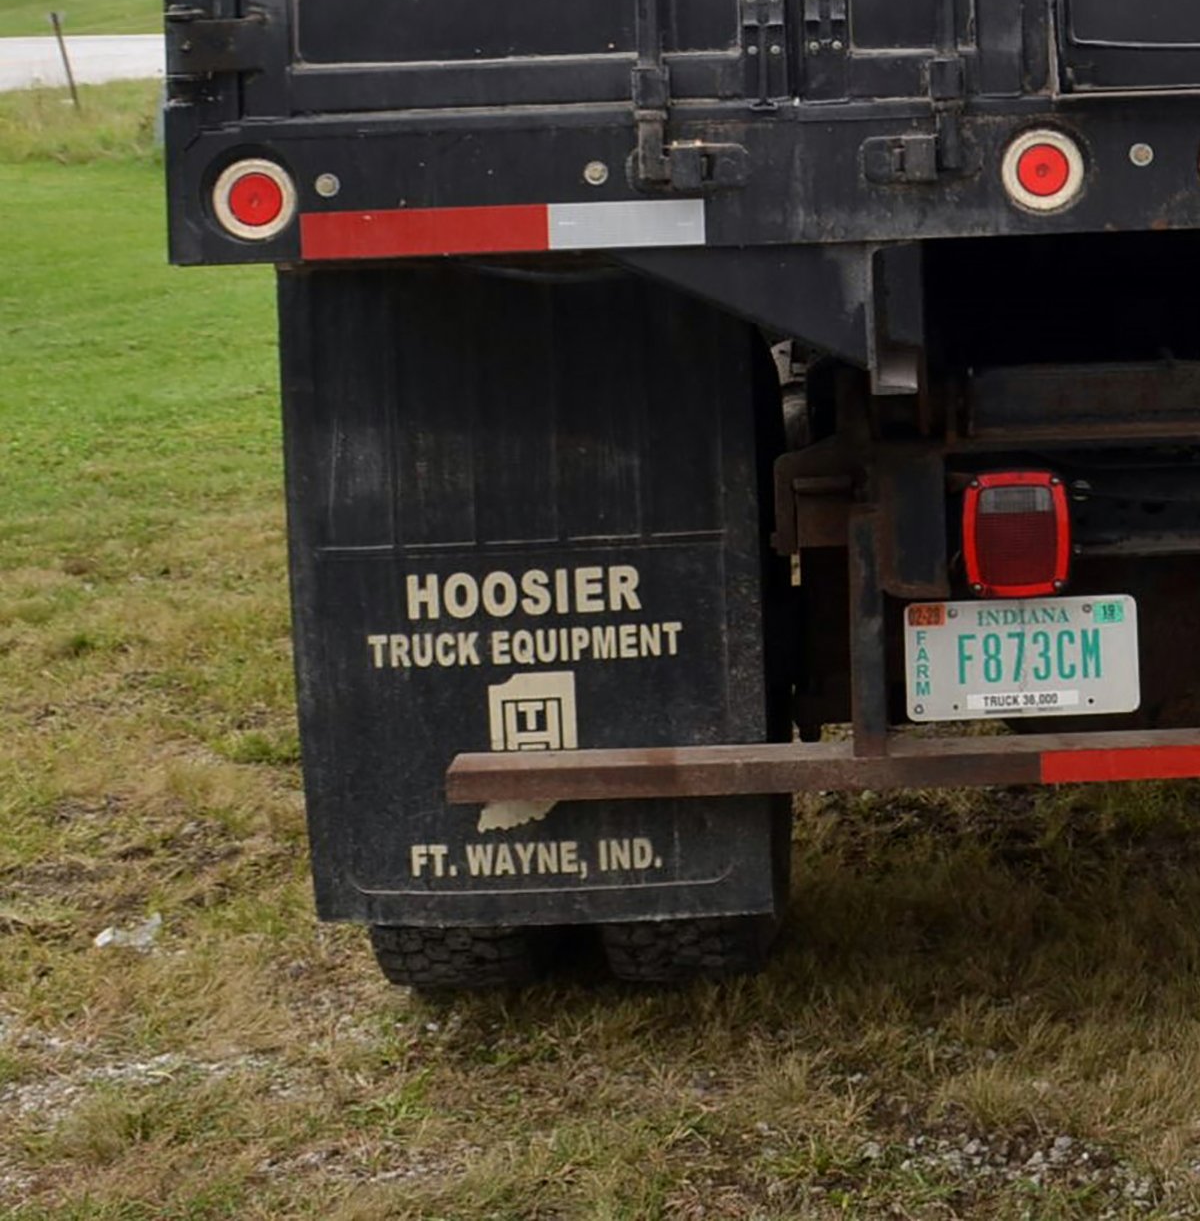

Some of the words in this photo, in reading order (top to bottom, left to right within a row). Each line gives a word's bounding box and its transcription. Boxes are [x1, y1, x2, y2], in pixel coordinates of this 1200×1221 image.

[406, 564, 642, 620] HOOSIER
[977, 607, 1070, 627] INDIANA
[367, 631, 480, 668] TRUCK
[492, 622, 682, 665] EQUIPMENT
[957, 628, 1102, 685] F873CM
[983, 694, 1019, 707] TRUCK
[410, 844, 457, 877] FT.
[466, 840, 588, 879] WAYNE,
[598, 837, 662, 872] IND.
